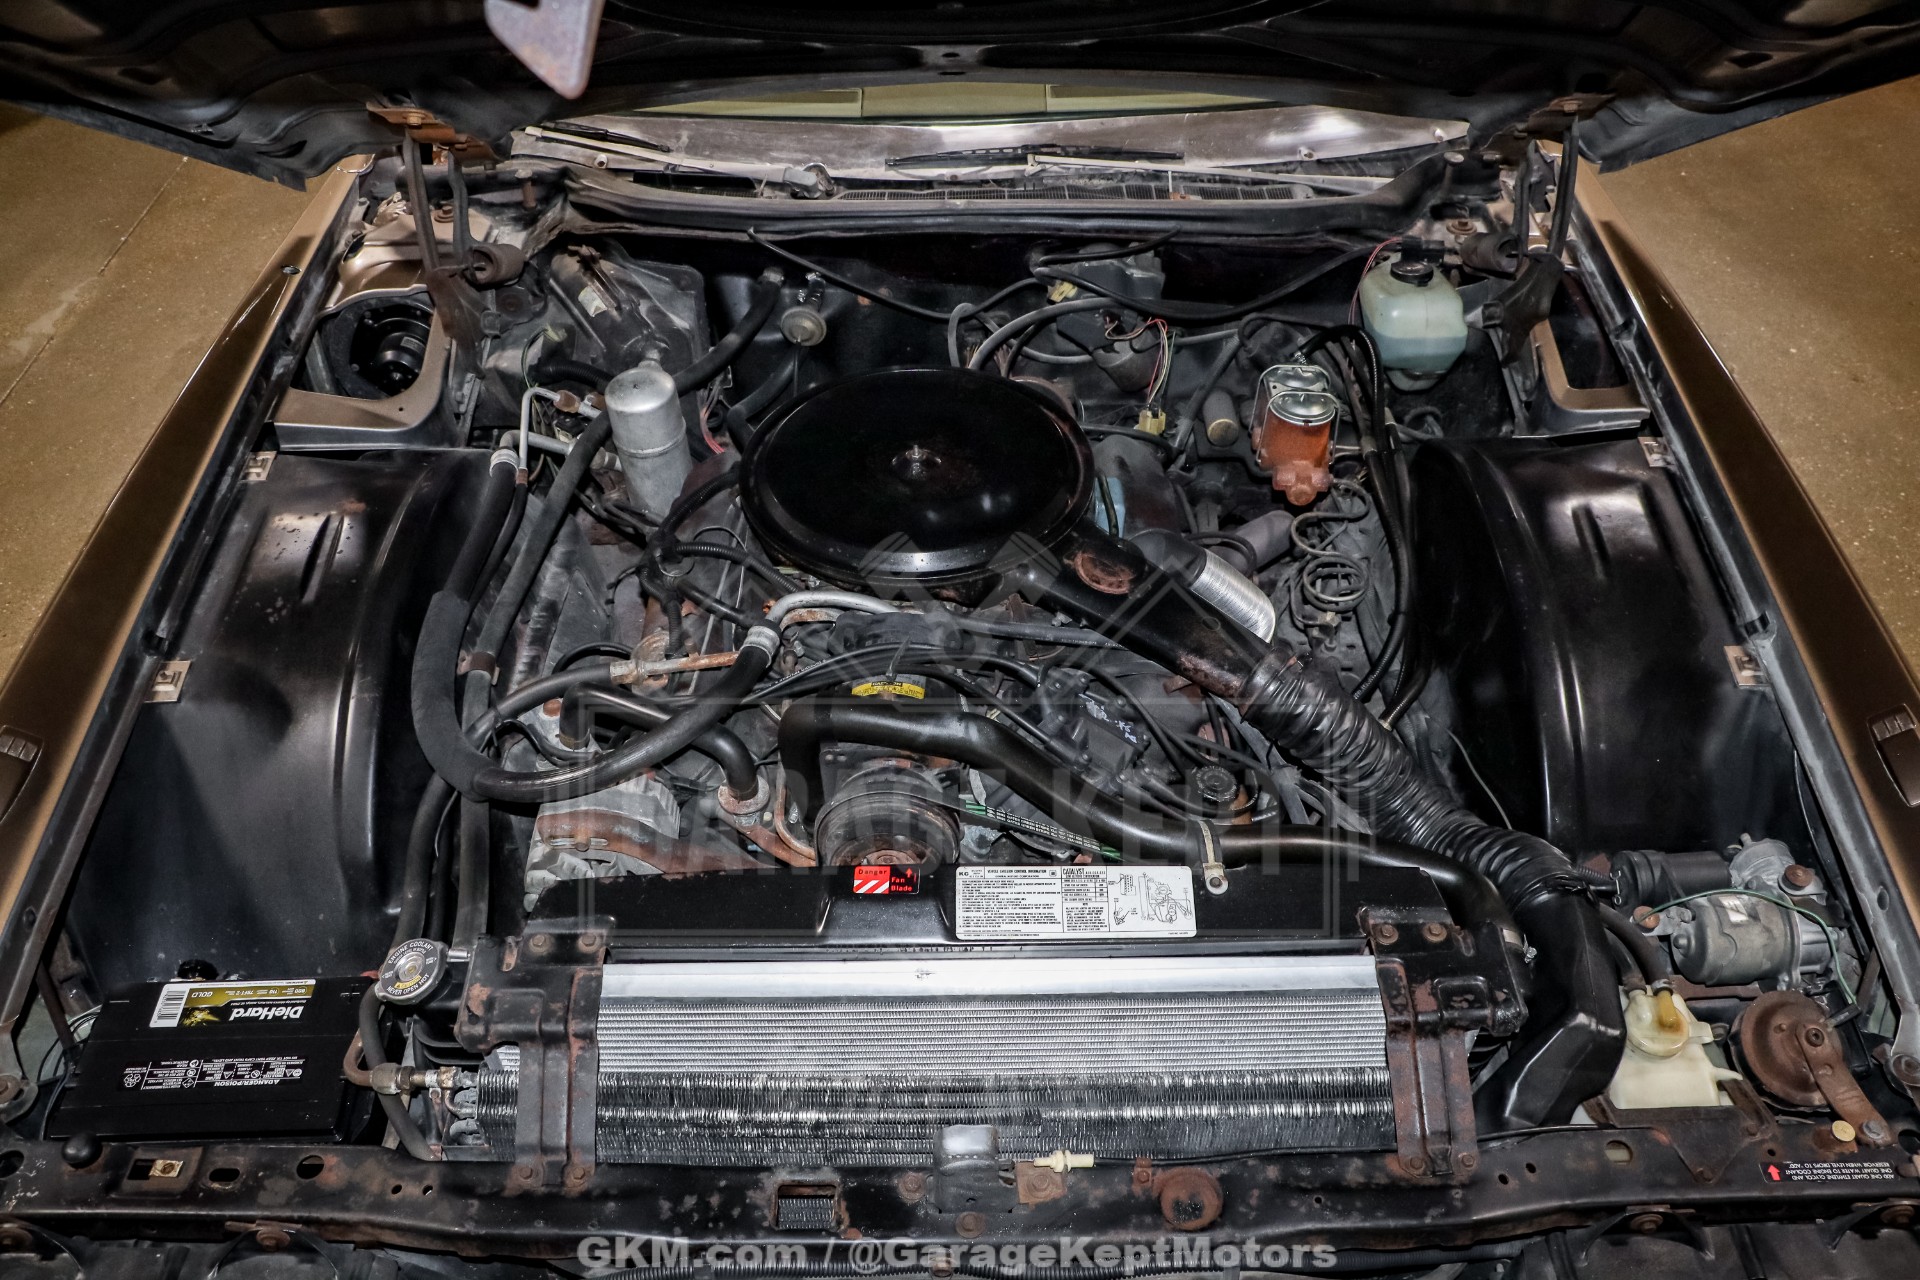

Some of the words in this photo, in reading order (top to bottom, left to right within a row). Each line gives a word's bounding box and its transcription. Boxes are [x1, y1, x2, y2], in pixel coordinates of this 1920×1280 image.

[388, 945, 408, 964] ENGINE
[410, 941, 433, 950] COOLANT
[387, 986, 402, 995] NEVER
[403, 984, 418, 994] OPEN
[419, 973, 429, 985] HOT
[229, 1006, 304, 1021] DieHard
